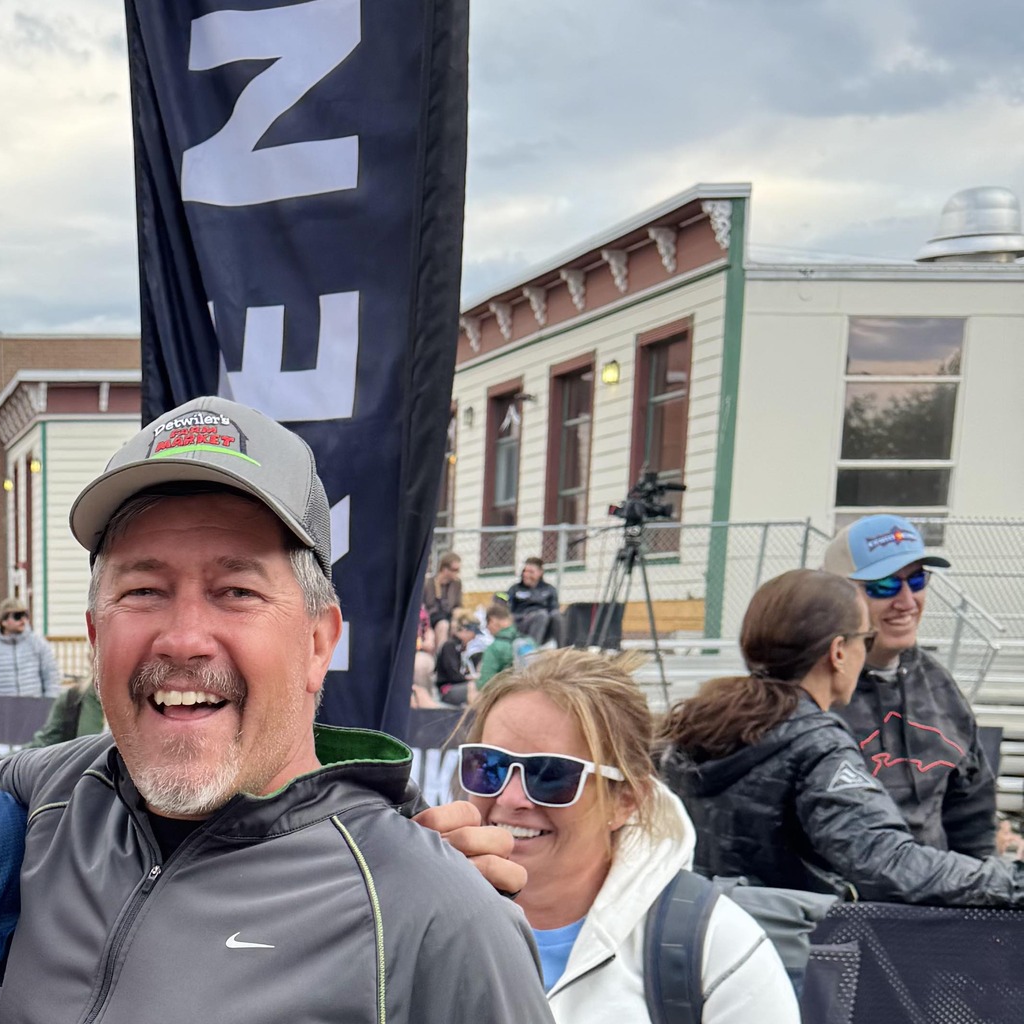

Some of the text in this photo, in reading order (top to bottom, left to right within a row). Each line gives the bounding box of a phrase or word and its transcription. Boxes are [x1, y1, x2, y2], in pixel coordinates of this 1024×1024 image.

[154, 412, 231, 437] Detwiler's
[169, 425, 217, 439] FARM
[155, 433, 236, 453] MARKET
